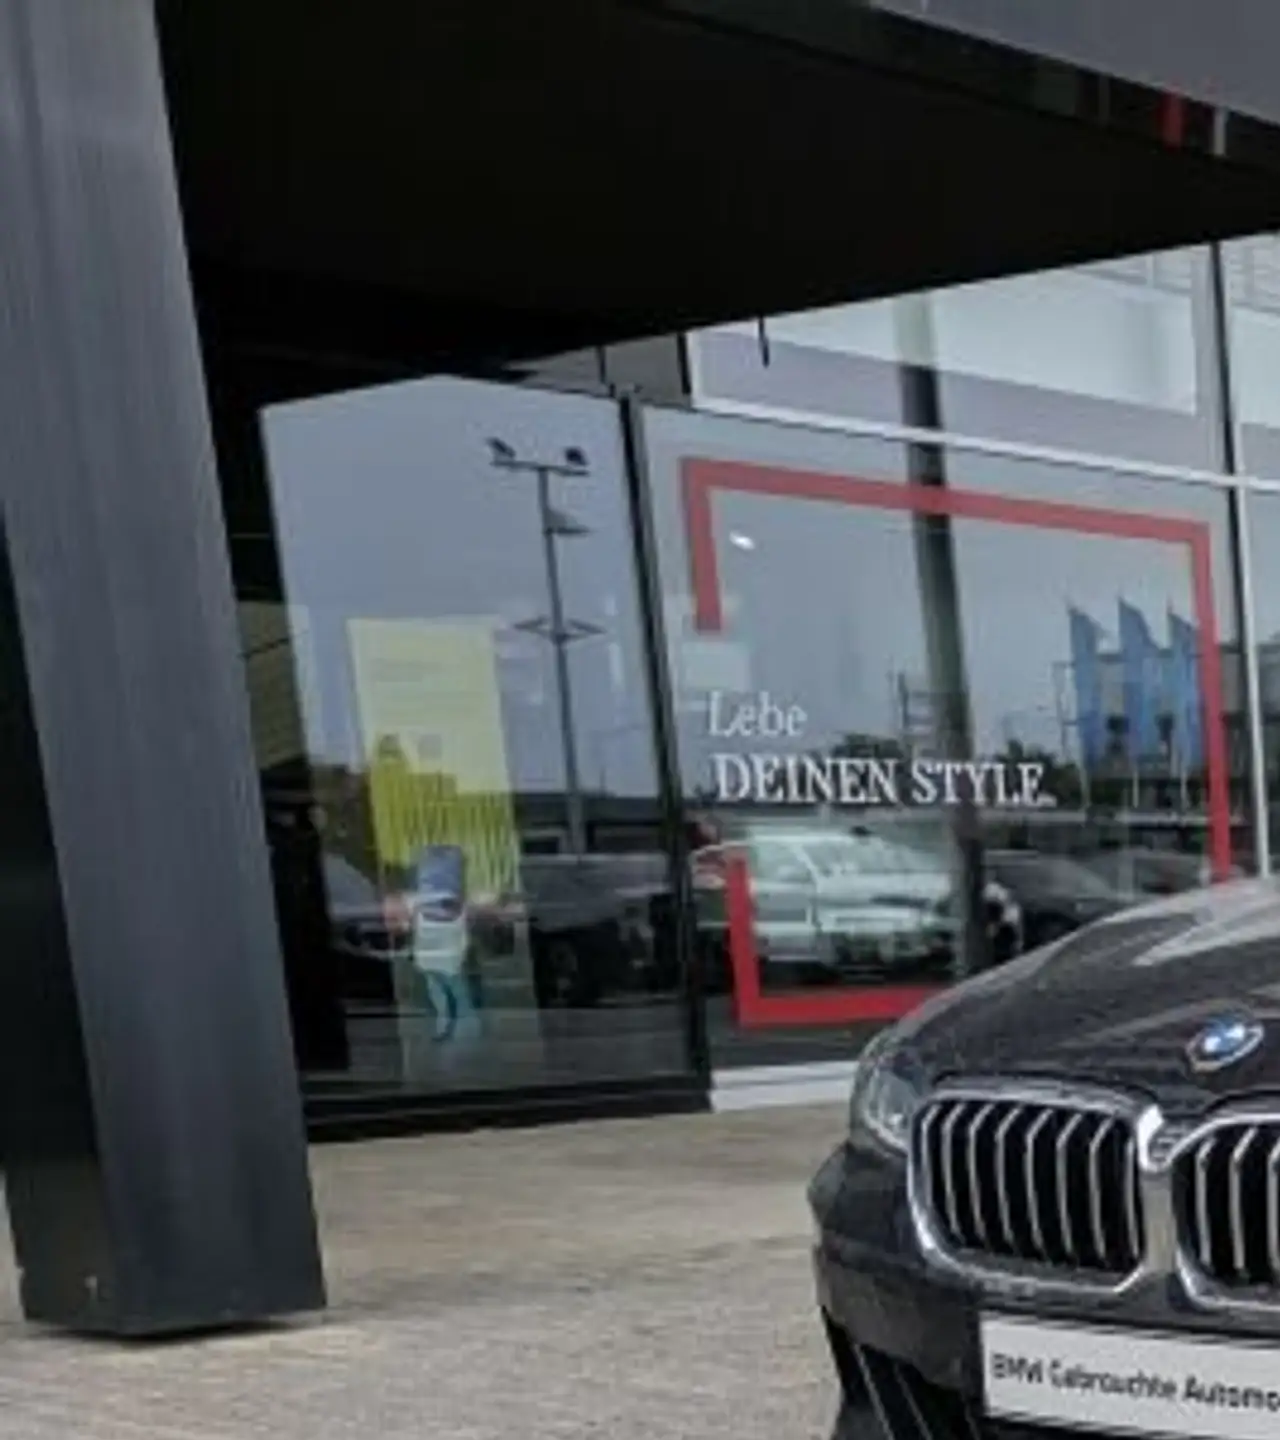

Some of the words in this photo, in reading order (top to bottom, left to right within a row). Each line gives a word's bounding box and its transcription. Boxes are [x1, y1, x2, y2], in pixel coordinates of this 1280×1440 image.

[709, 690, 807, 737] Lebe
[712, 753, 899, 804] DEINEN
[911, 758, 1057, 807] STYLE.
[992, 1353, 1043, 1384] BMW
[1050, 1359, 1177, 1398] Gebrauchte
